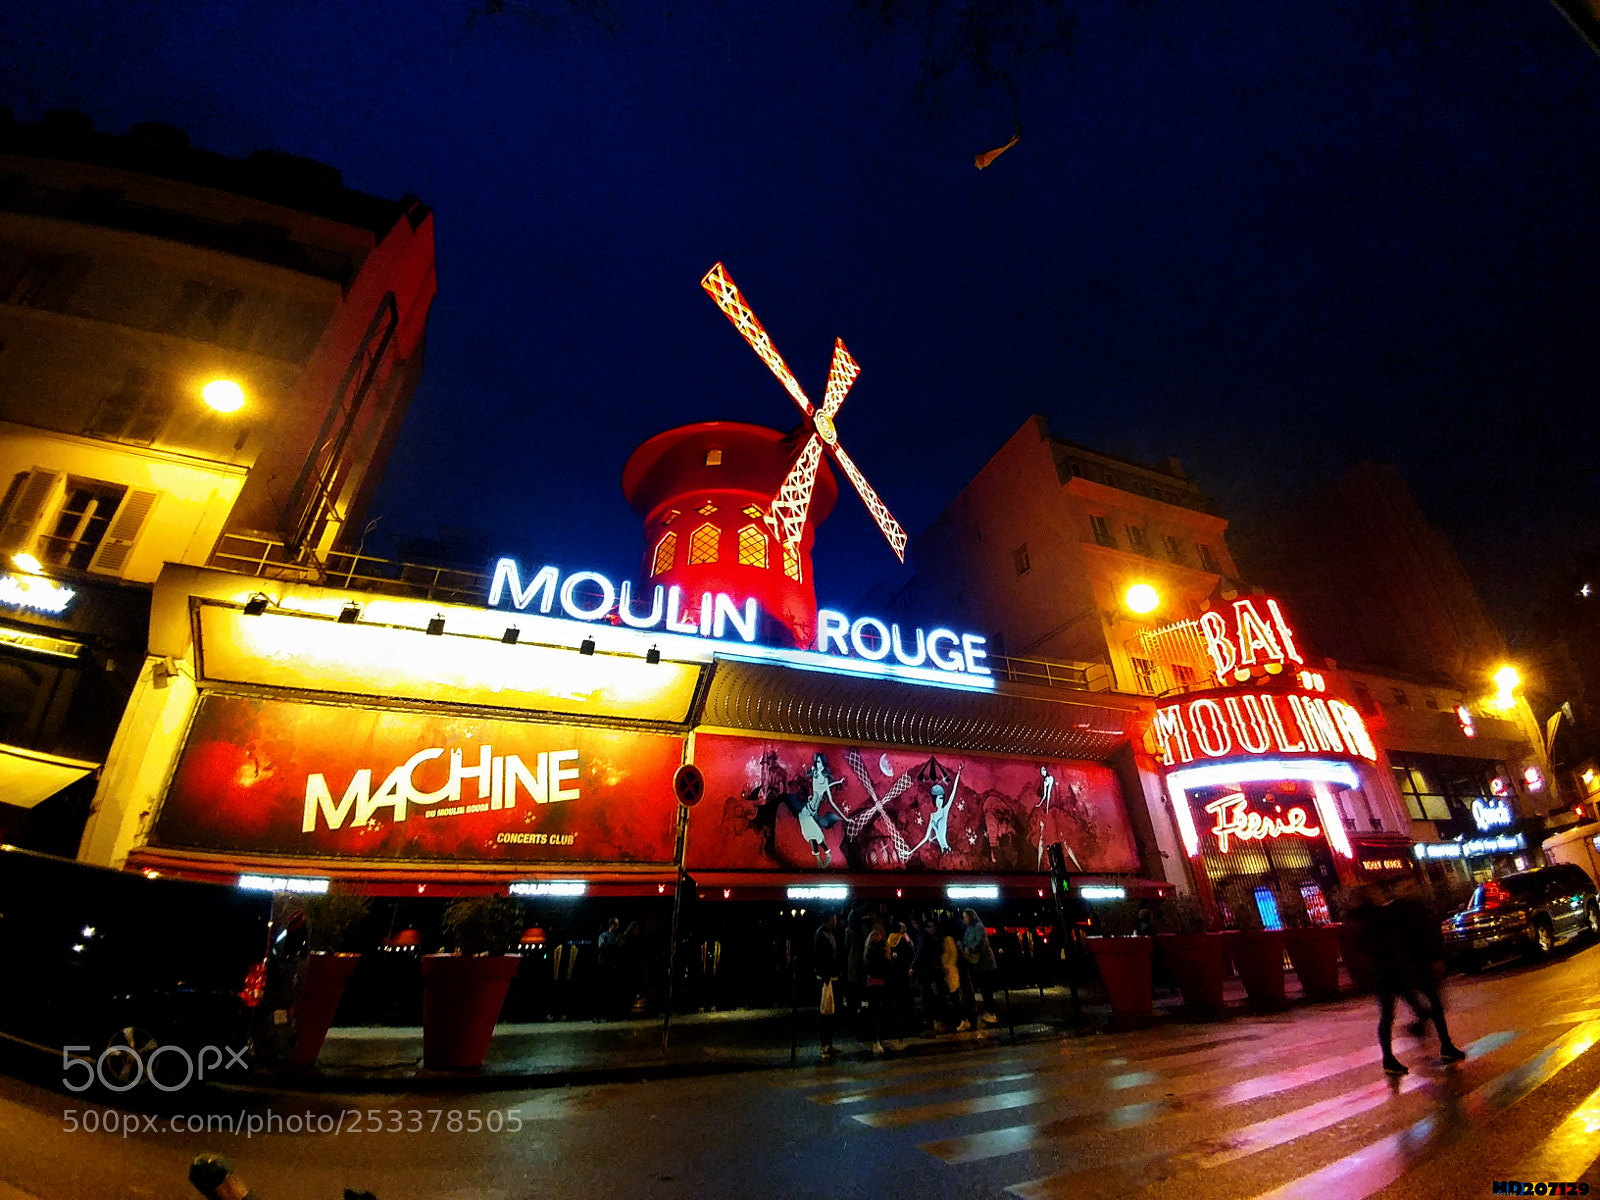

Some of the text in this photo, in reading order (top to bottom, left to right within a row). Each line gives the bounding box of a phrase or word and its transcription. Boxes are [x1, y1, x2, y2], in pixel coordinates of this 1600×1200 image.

[488, 558, 993, 676] MOULIN ROUGE
[302, 745, 580, 833] MACHINE
[437, 806, 466, 818] MOULIN
[497, 832, 575, 846] CONCERTS CLUB
